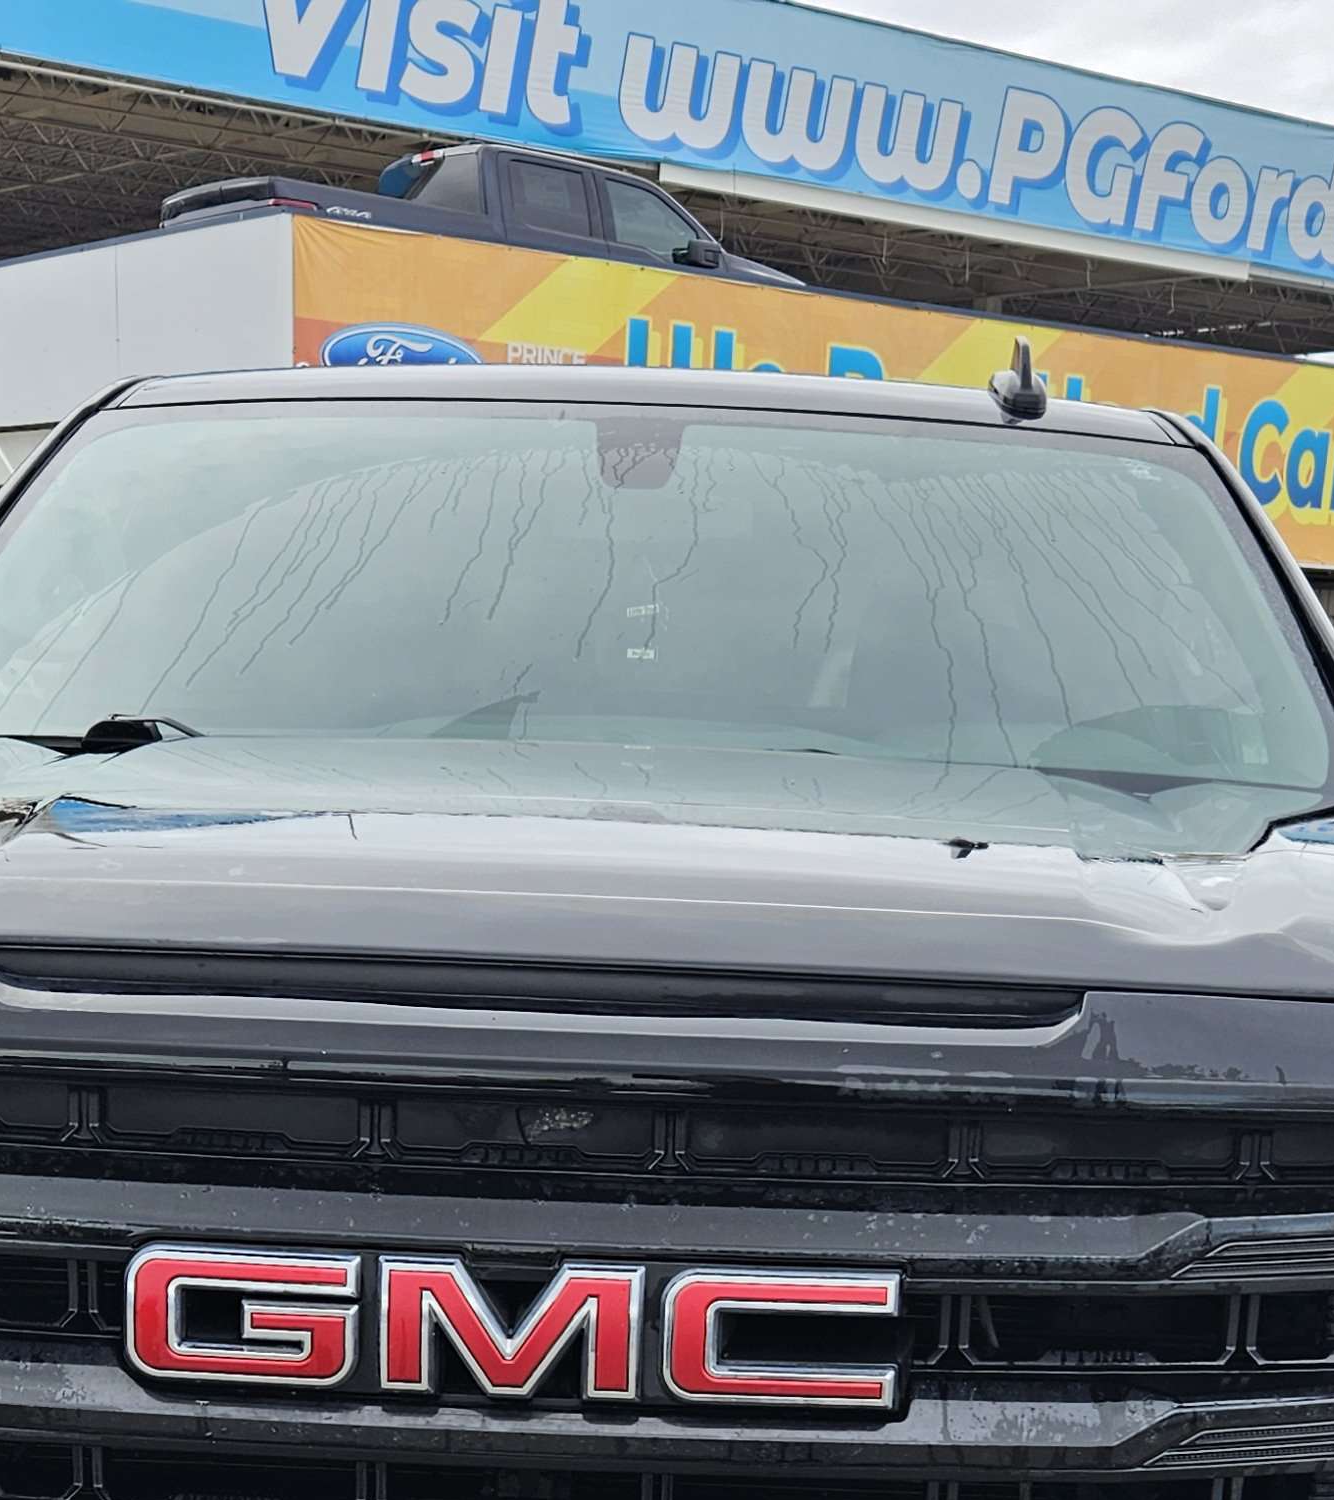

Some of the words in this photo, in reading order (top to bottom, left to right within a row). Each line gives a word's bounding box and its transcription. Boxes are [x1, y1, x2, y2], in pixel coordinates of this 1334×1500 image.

[264, 0, 583, 128] Visit
[507, 342, 587, 365] PRINCE
[124, 1243, 904, 1411] GMC
